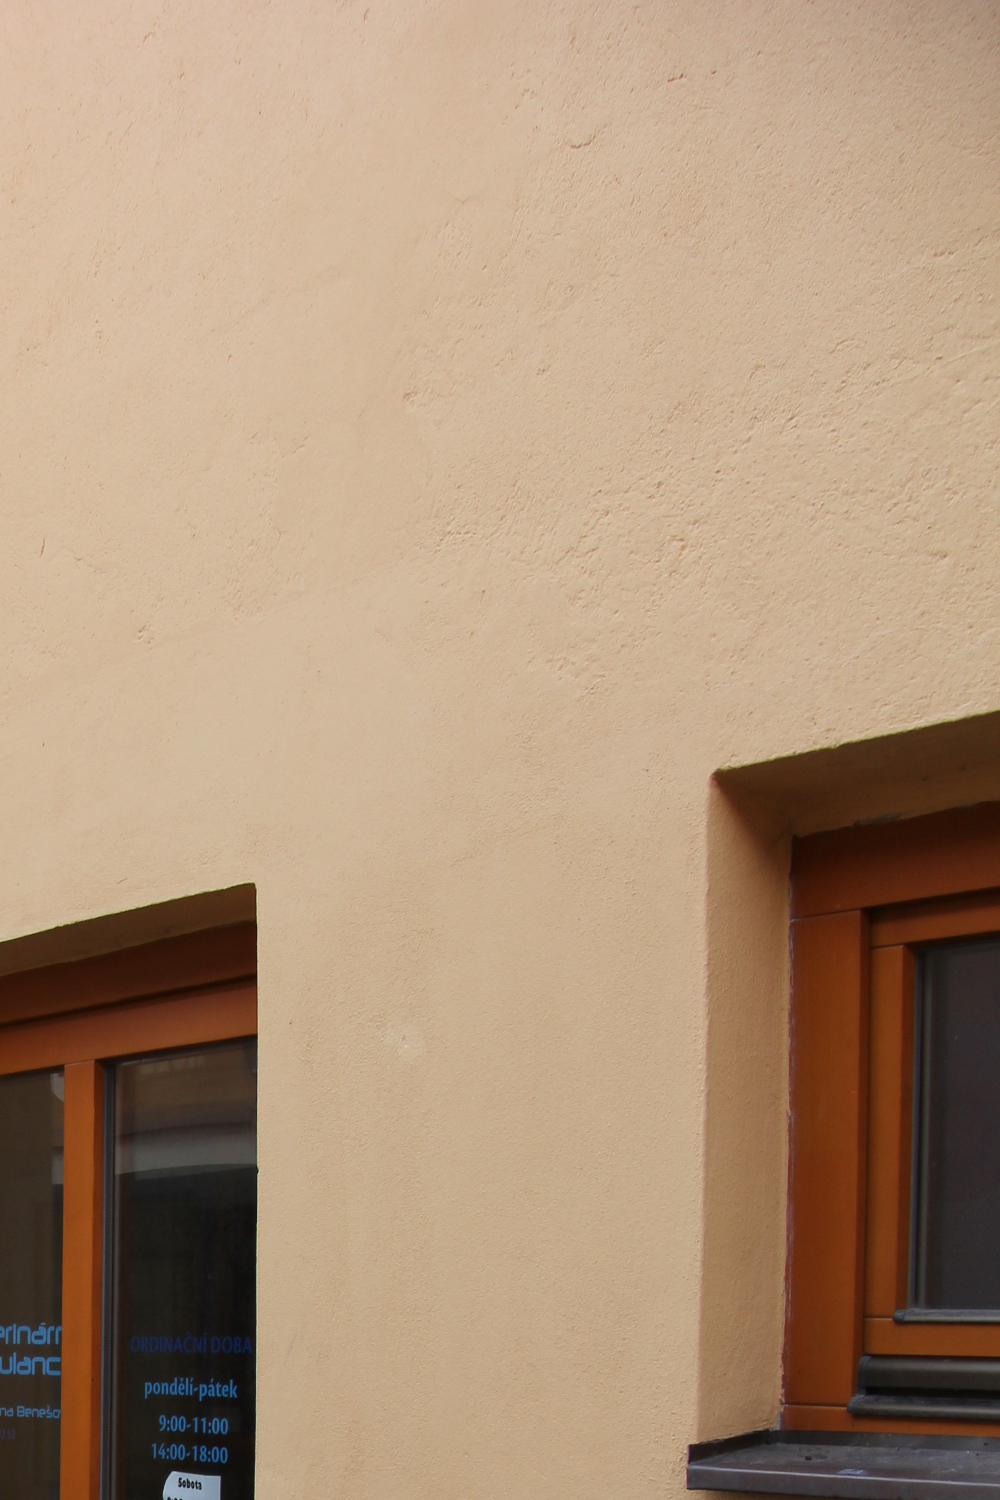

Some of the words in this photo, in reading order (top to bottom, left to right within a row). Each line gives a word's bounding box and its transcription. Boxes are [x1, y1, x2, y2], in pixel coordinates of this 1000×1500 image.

[129, 1331, 208, 1354] ORDINAČNÍ
[210, 1335, 253, 1355] DOBA
[144, 1377, 238, 1402] pondělí-pátek
[158, 1414, 229, 1435] 9:00-11:00
[151, 1442, 229, 1464] 14:00-18:00
[178, 1477, 202, 1490] Sobota
